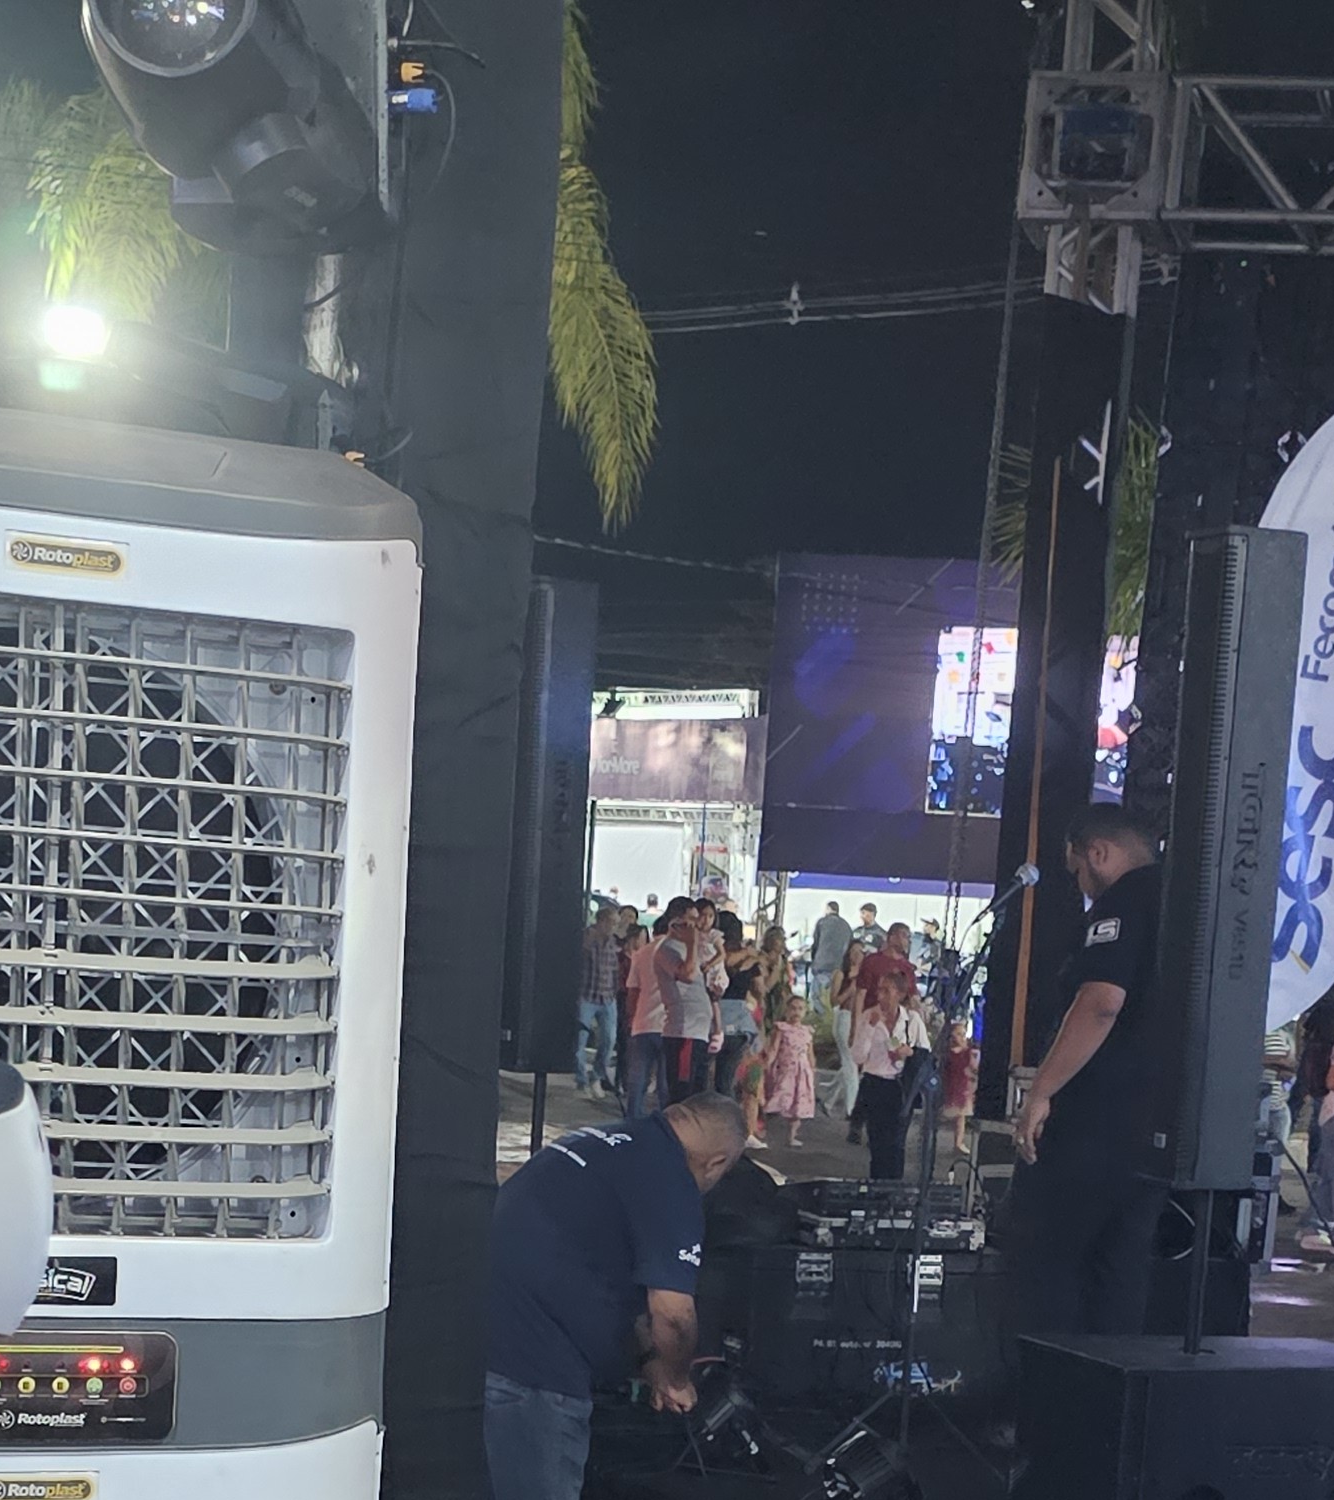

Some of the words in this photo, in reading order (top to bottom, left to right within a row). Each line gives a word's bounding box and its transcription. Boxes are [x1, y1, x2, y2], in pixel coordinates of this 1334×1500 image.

[33, 546, 115, 569] Rotoplast
[17, 1412, 88, 1427] Rotoplast
[7, 1483, 86, 1499] Rotoplast
